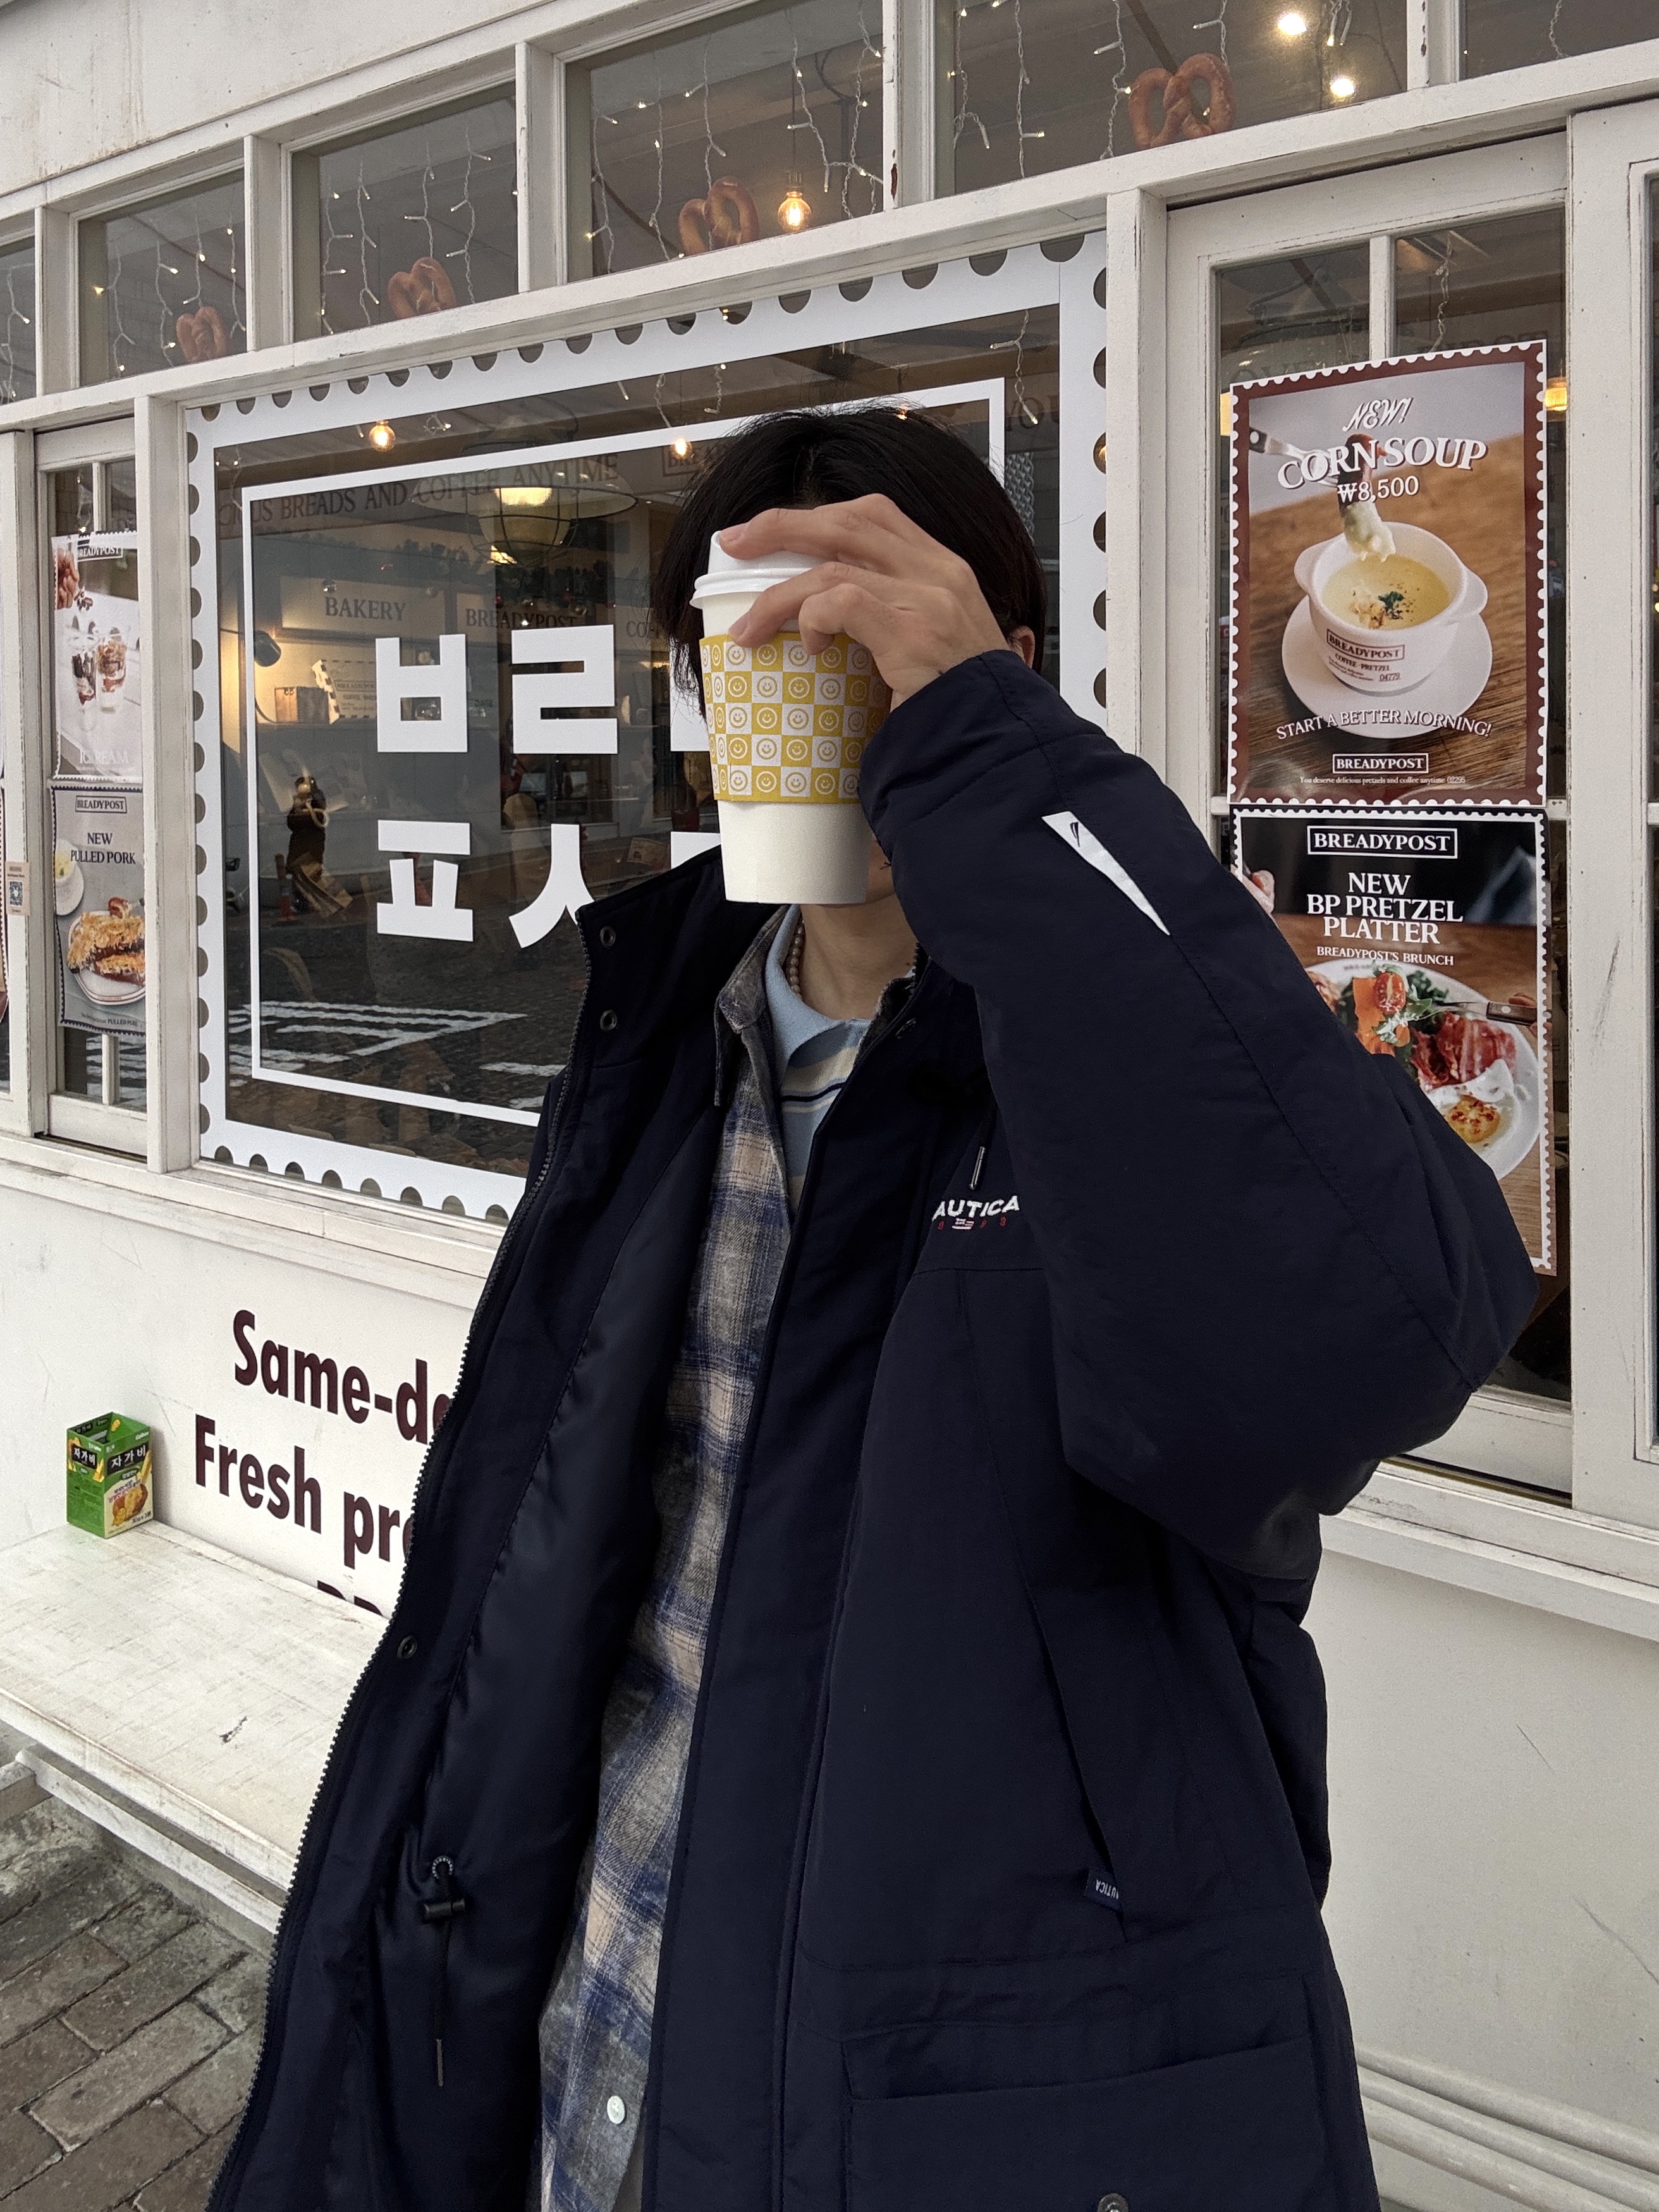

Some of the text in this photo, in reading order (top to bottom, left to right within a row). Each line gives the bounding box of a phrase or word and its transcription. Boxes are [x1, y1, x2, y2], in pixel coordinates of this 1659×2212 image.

[1343, 397, 1413, 432] NEW!
[1278, 436, 1488, 489] CORN SOUP
[280, 488, 356, 520] BREADS
[365, 482, 408, 510] AND
[1337, 476, 1419, 503] ₩8,500
[325, 596, 406, 621] BAKERY
[466, 608, 577, 629] BREADYPOST
[1329, 634, 1401, 658] BREADYPOST
[1276, 710, 1493, 740] START A BETTER MORNING!
[1336, 758, 1424, 770] BREADYPOST
[1300, 776, 1312, 784] You
[1336, 776, 1362, 784] delicious
[1387, 776, 1399, 784] and
[1399, 776, 1419, 784] coffee
[77, 799, 124, 810] BREADYPOST
[87, 832, 113, 845] NEW
[1314, 833, 1450, 852] BREADYPOST
[70, 849, 136, 865] PULLED PORK
[1348, 872, 1411, 895] NEW
[1307, 894, 1463, 923] BP PRETZEL
[1324, 916, 1440, 944] PLATTER
[1316, 946, 1454, 966] BREADYPOST'S BRUNCH
[74, 1447, 96, 1466] 자가비
[111, 1444, 146, 1468] 자가비
[195, 1413, 321, 1535] Fresh
